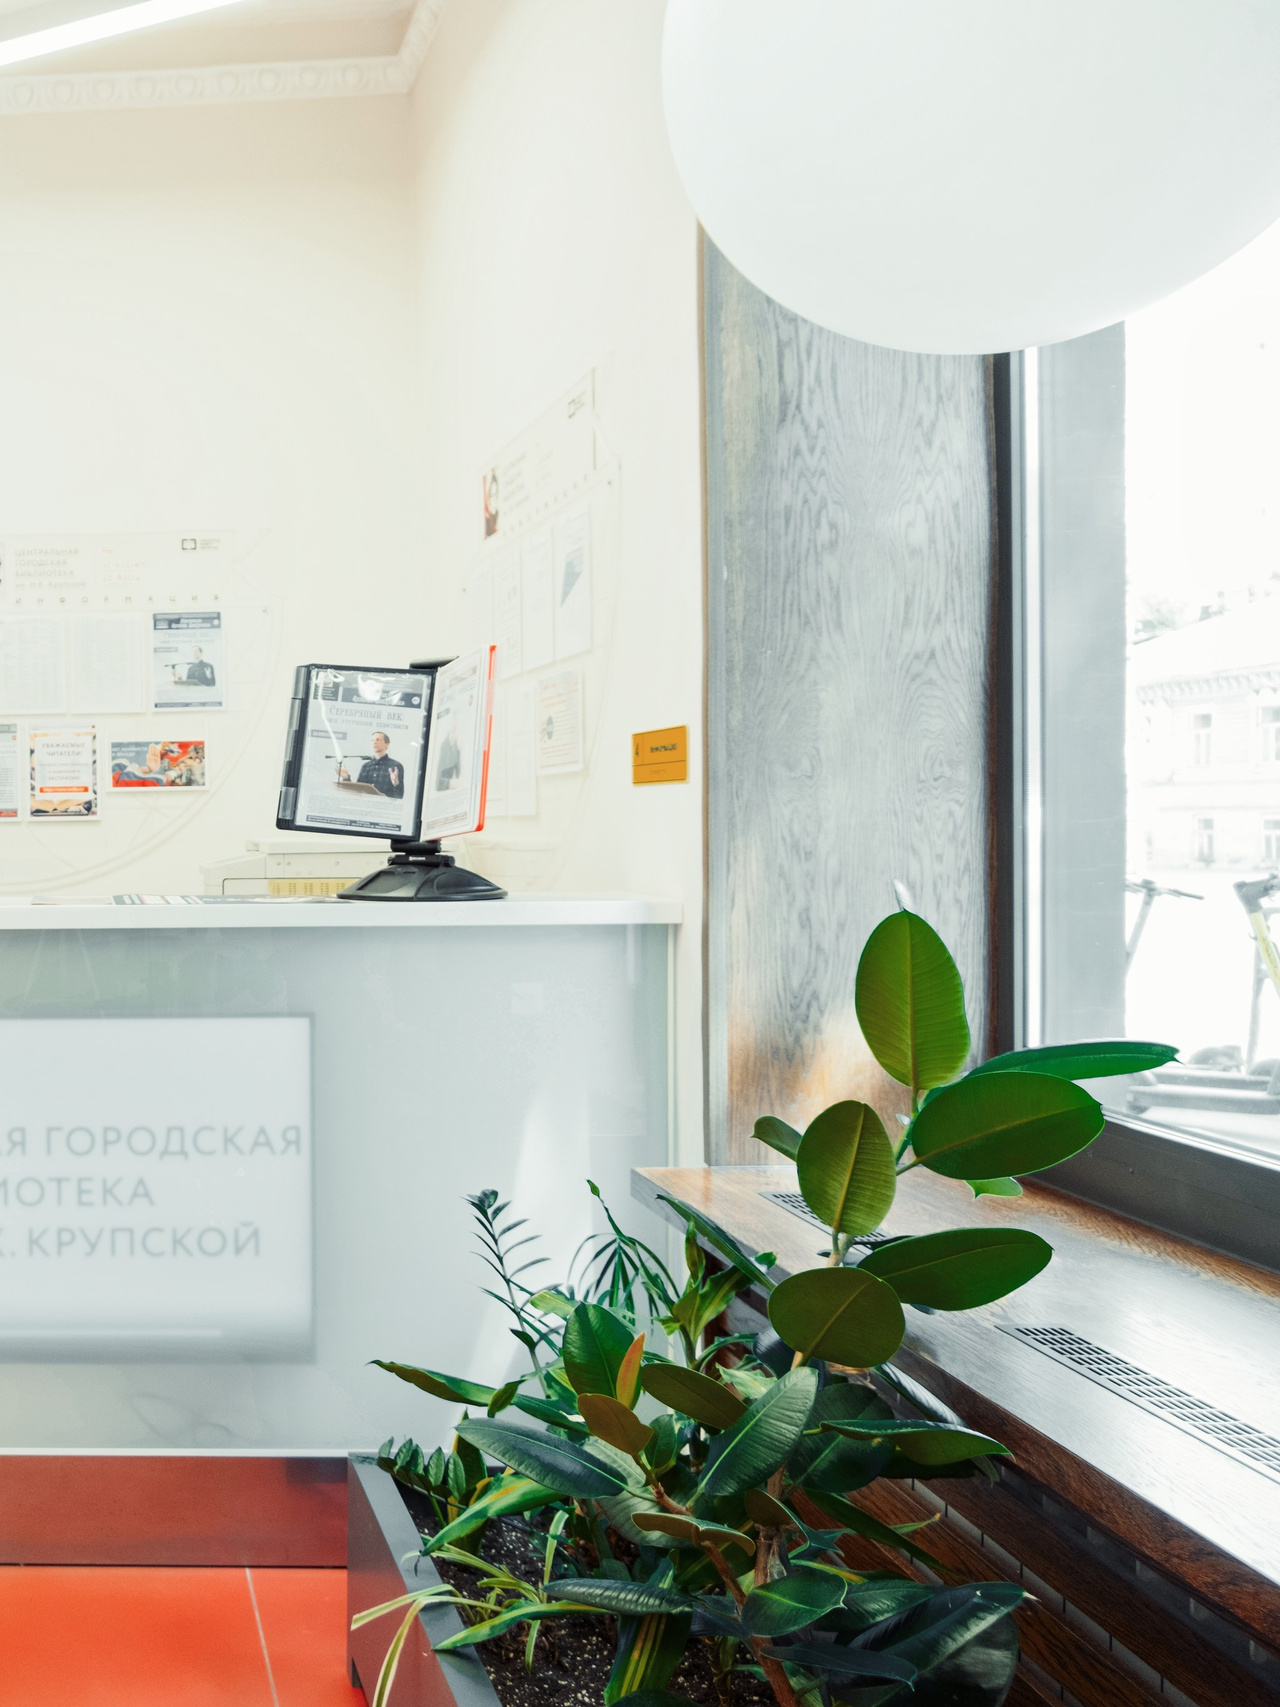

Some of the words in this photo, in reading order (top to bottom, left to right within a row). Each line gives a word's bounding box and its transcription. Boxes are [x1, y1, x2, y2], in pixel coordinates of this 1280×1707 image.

[14, 547, 80, 557] ЦЕНТРАЛЬНАЯ
[14, 558, 68, 567] ГОРОДСКАЯ
[14, 569, 75, 577] БИБЛИОТЕКА
[45, 1125, 303, 1161] ГОРОДСКАЯ
[27, 1221, 264, 1258] КРУПСКОЙ
